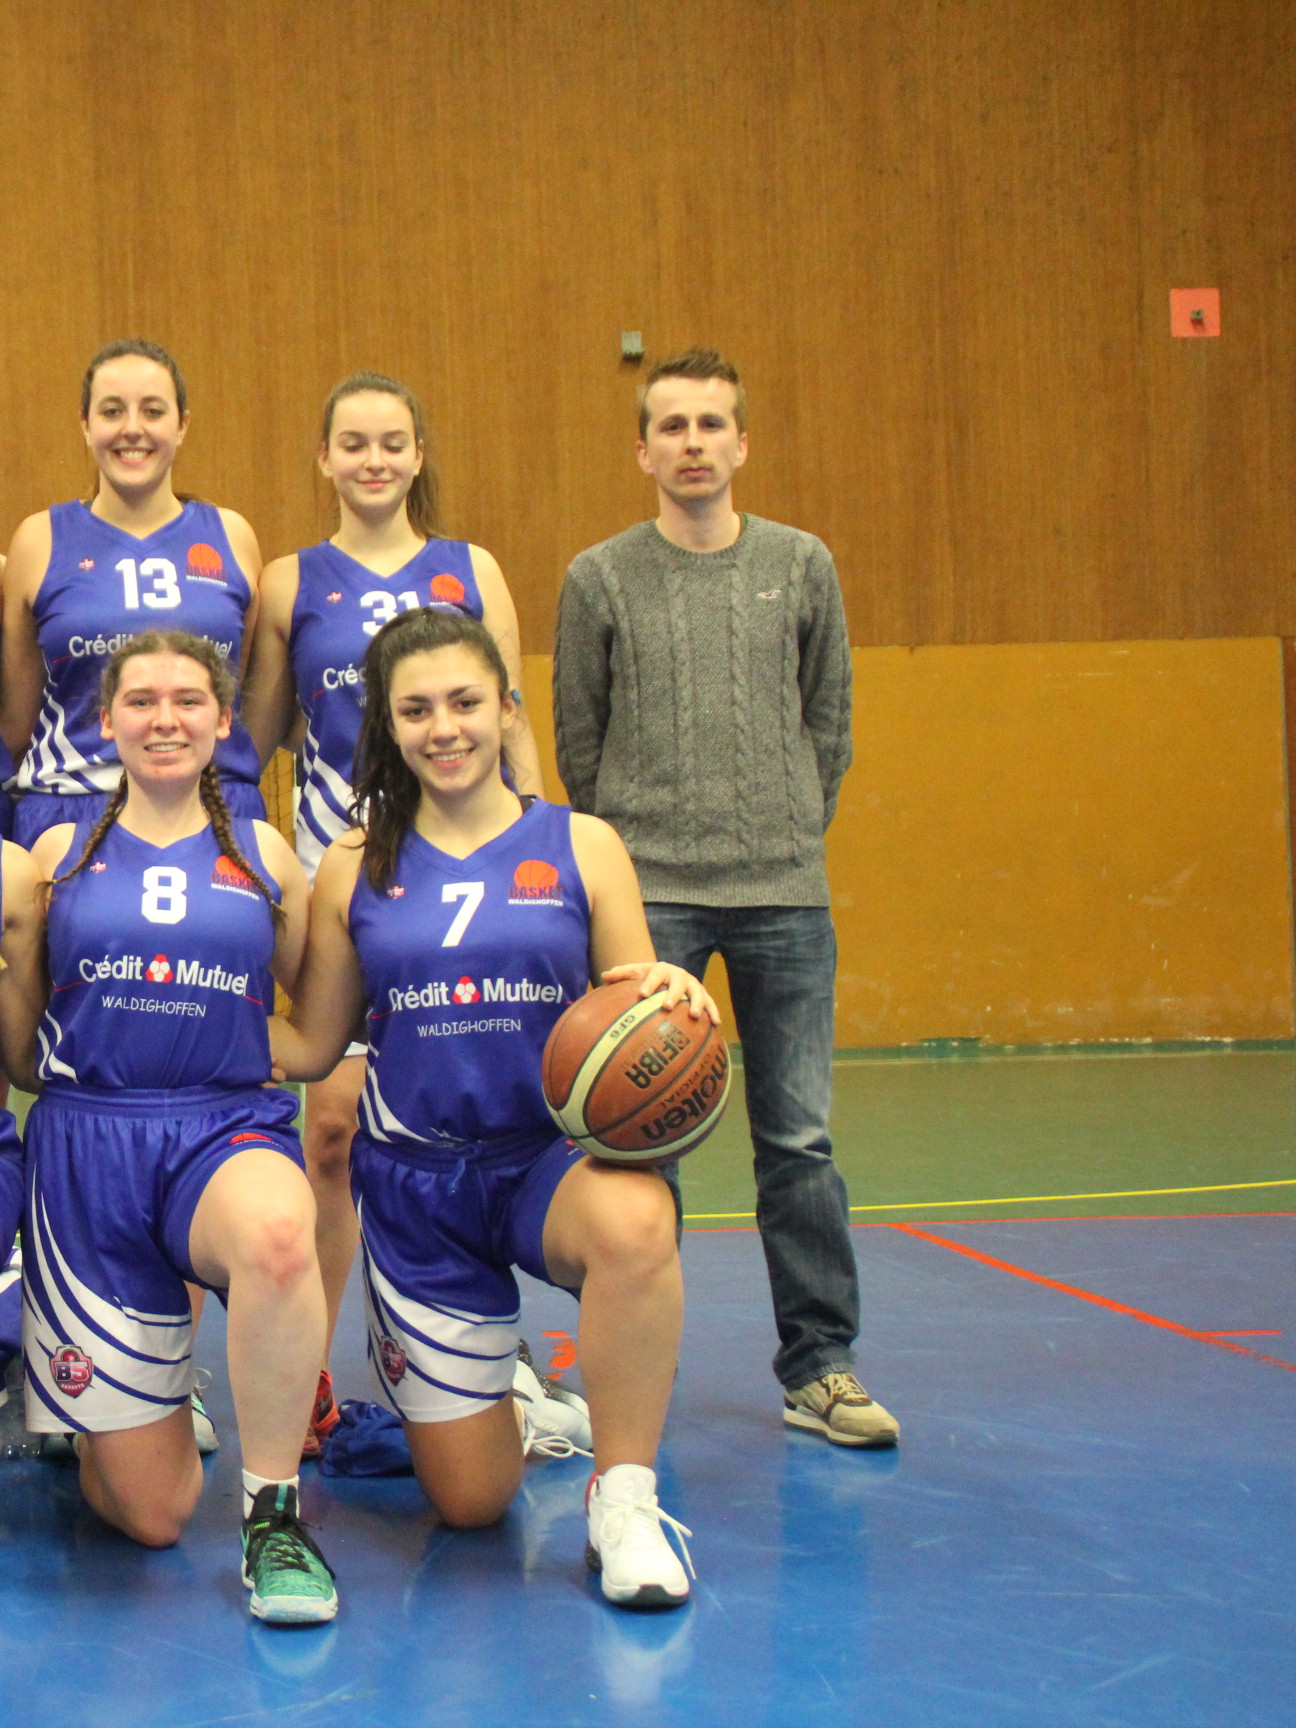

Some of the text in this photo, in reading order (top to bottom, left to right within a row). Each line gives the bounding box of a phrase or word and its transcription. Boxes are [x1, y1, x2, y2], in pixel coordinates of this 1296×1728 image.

[115, 557, 182, 610] 13
[141, 866, 188, 924] 8
[508, 898, 564, 907] WALDIGHOFFEN
[509, 885, 563, 899] BASKET
[441, 881, 485, 948] 7
[79, 954, 249, 997] Crédit Mutuel
[389, 977, 564, 1012] Crédit Mutuel
[102, 995, 207, 1017] WALDIGHOFFEN
[417, 1018, 522, 1037] WALDIGHOFFEN
[624, 1036, 684, 1090] FIBA
[640, 1044, 728, 1141] molten
